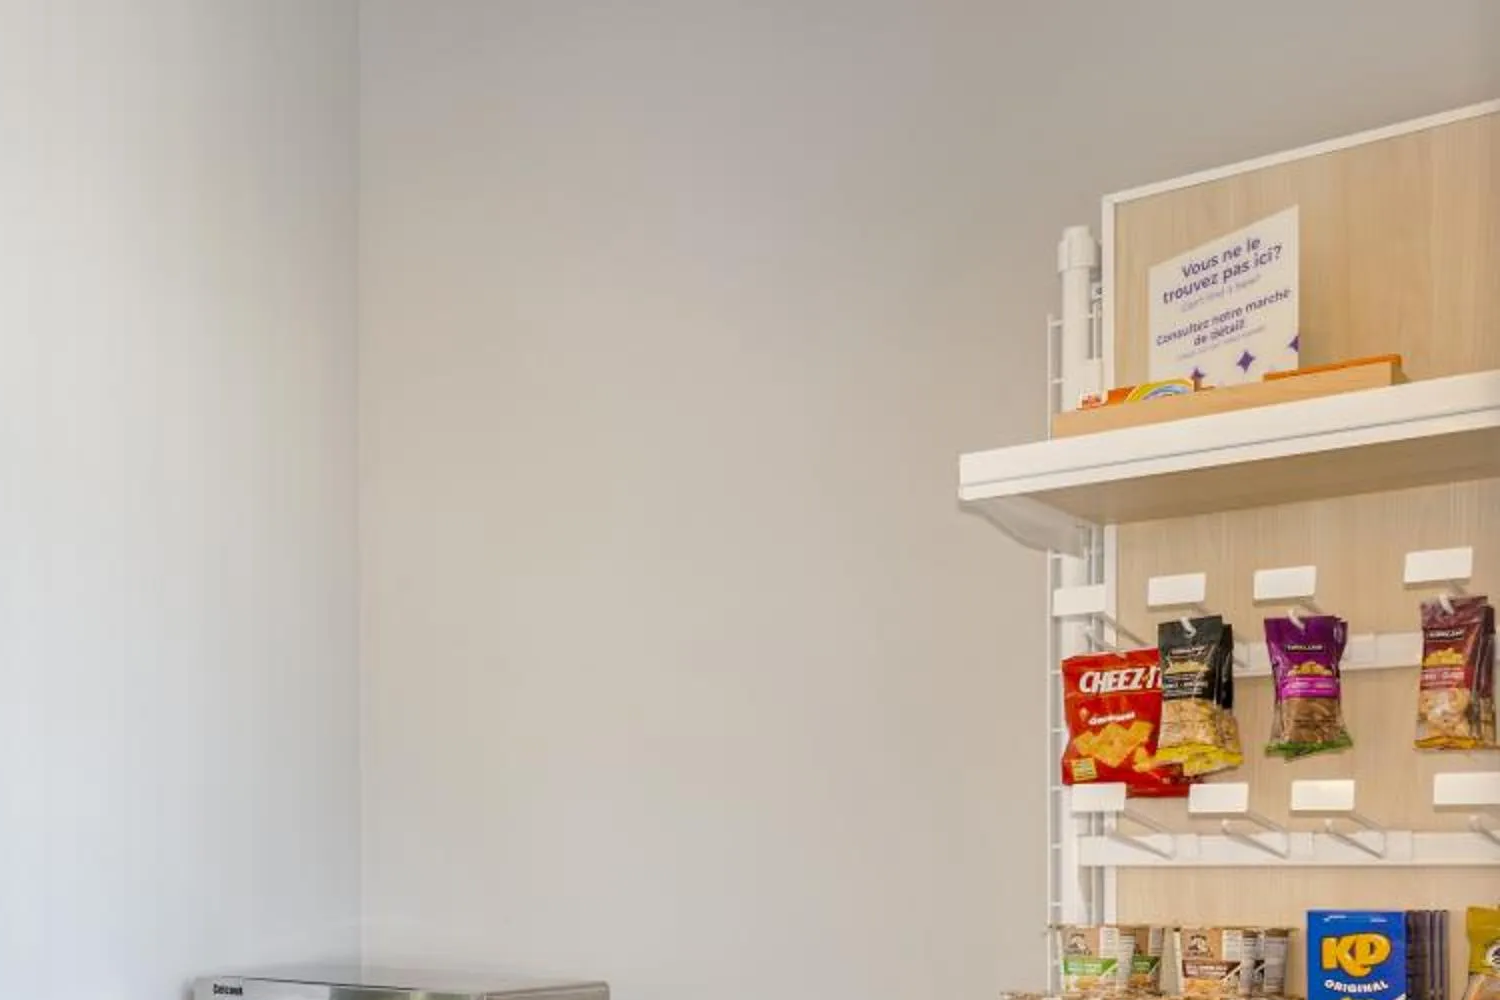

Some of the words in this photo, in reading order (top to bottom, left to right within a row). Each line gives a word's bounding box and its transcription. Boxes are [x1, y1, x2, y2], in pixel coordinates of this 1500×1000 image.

[1163, 273, 1218, 305] trouvez
[1223, 260, 1250, 283] pas
[1254, 244, 1282, 267] ici?
[1182, 255, 1219, 278] Vous
[1222, 245, 1242, 262] ne
[1247, 238, 1261, 252] le
[1156, 319, 1210, 347] Consultez
[1211, 306, 1243, 326] notre
[1193, 333, 1207, 346] de
[1324, 979, 1389, 993] ORIGINAL
